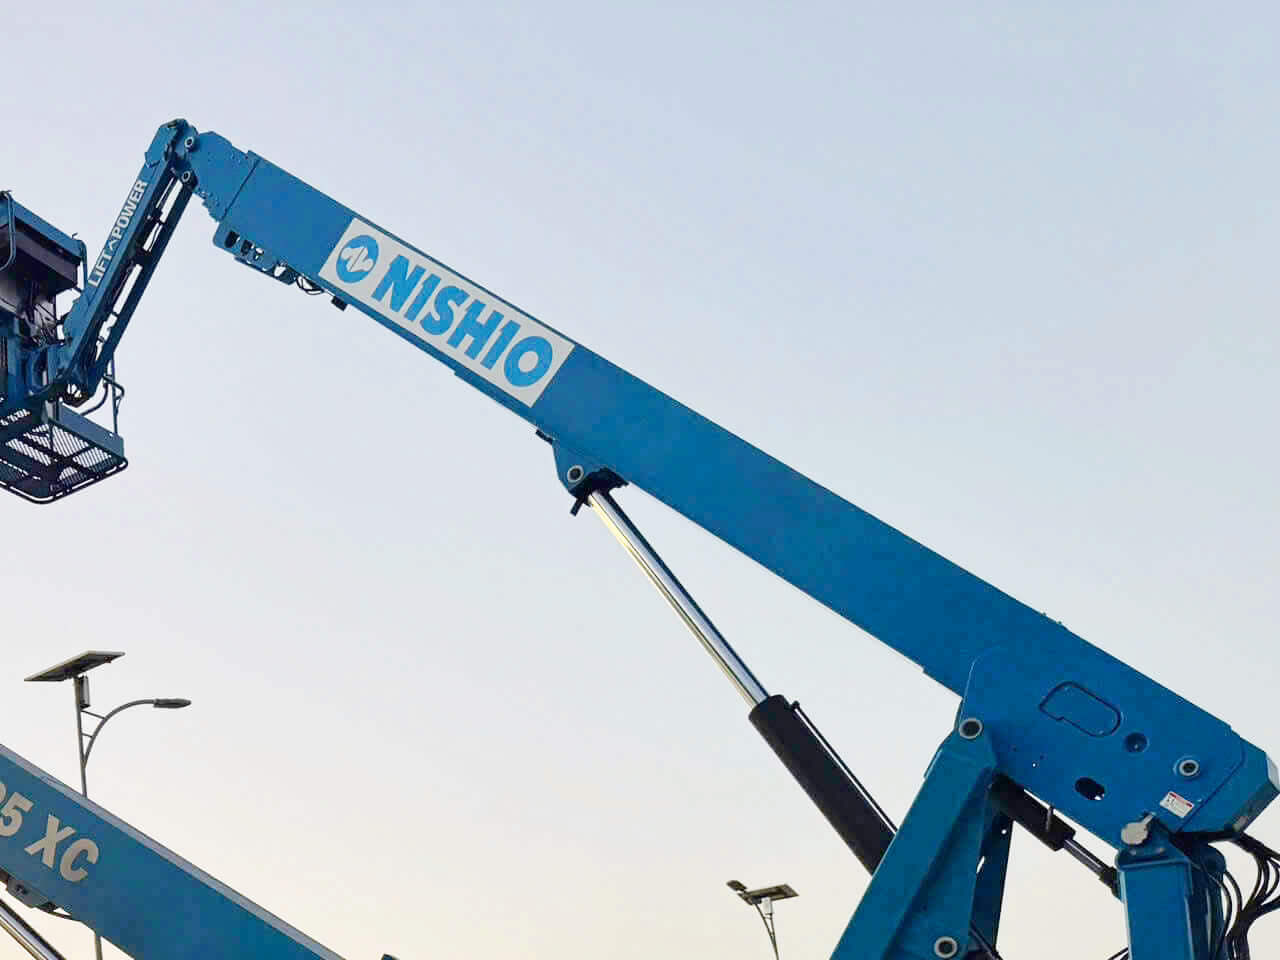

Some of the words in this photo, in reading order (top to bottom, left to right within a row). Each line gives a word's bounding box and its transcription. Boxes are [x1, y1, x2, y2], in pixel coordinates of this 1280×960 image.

[111, 180, 148, 240] POWER
[371, 254, 553, 388] NISHIO
[25, 814, 100, 883] XC
